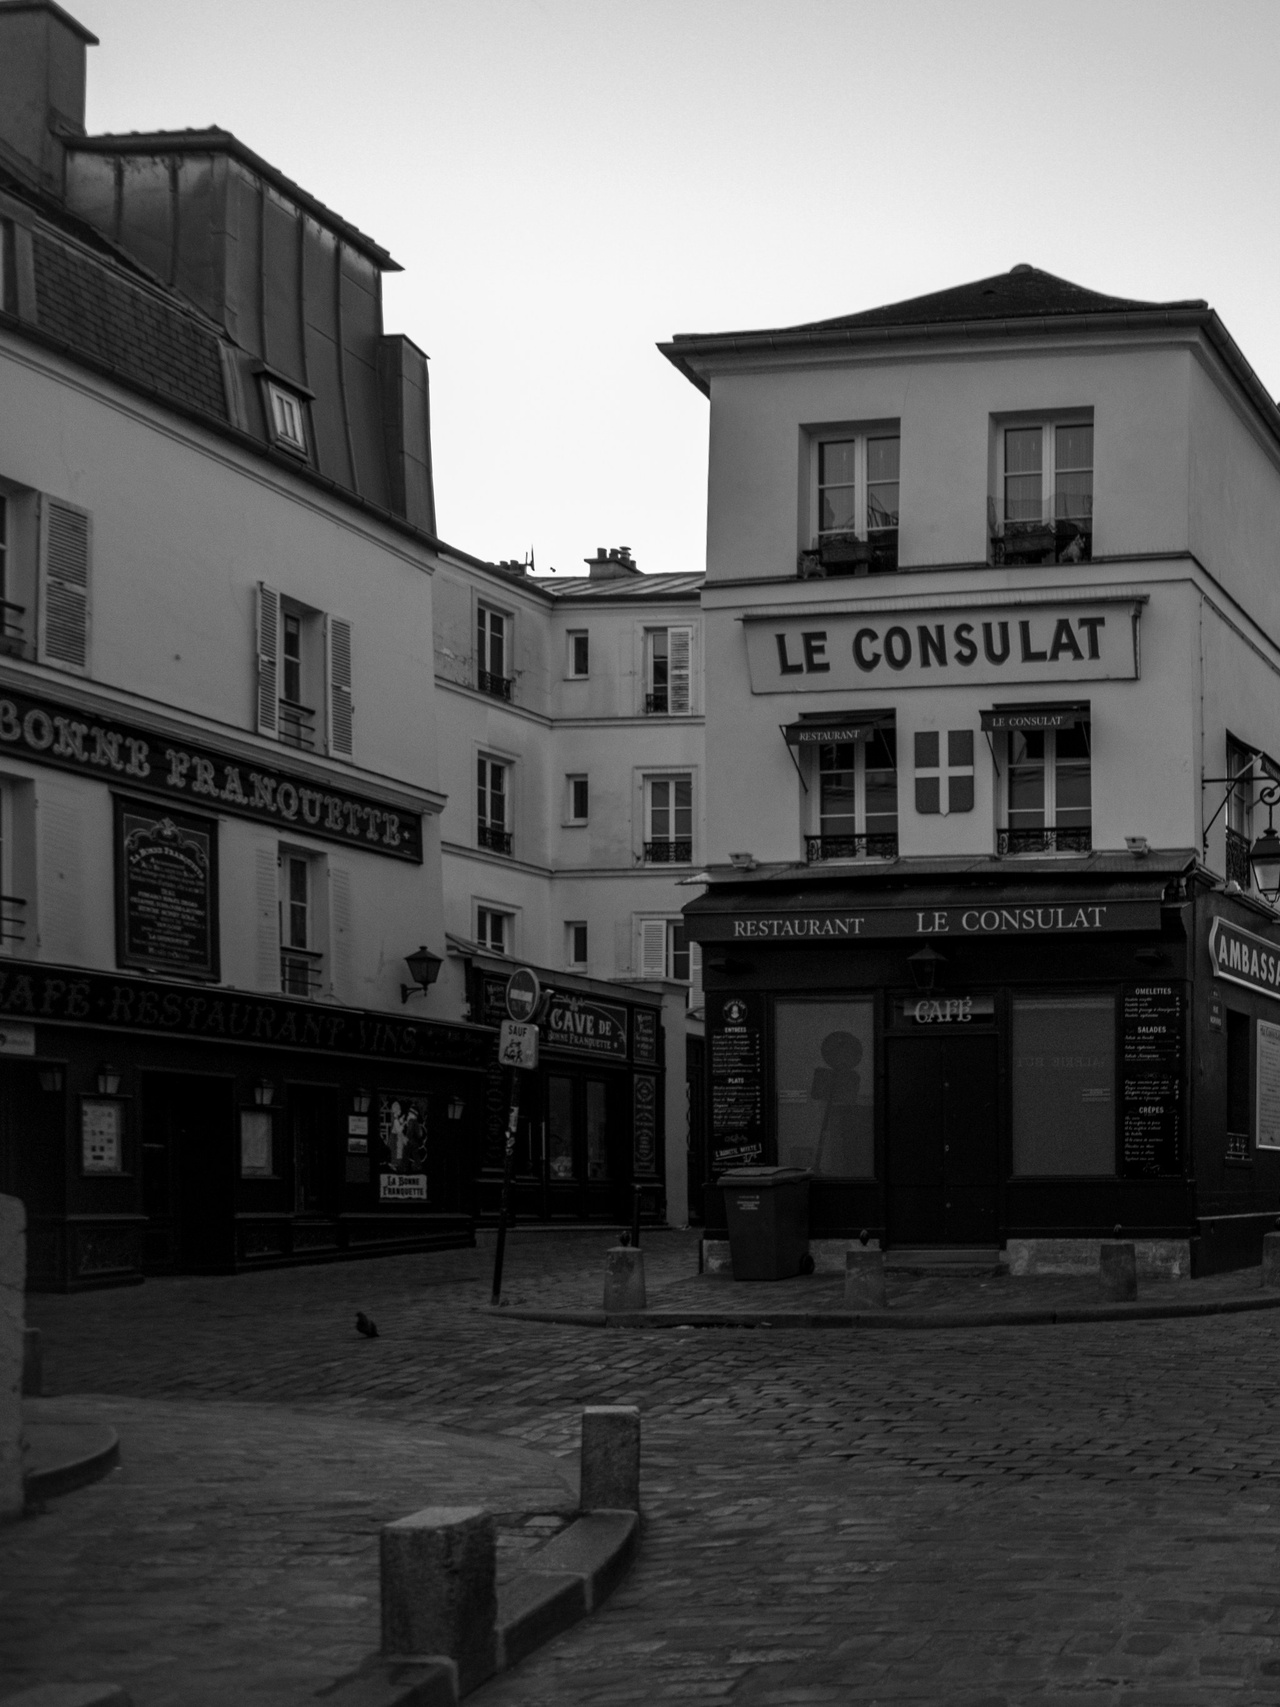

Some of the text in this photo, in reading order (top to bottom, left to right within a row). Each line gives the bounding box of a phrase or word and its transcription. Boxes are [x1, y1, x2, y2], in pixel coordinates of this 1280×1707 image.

[775, 617, 1105, 675] LE CONSULAT
[992, 715, 1063, 728] LE CONSULAT
[799, 729, 860, 743] RESTAURANT
[0, 699, 401, 846] BONNE FRANQUETTE
[733, 906, 1107, 937] RESTAURANT LE CONSULAT
[1135, 987, 1172, 995] OMELETTES
[914, 996, 973, 1025] CAFÉ
[107, 985, 346, 1047] RESTAURANT
[359, 1018, 418, 1055] VINS
[550, 1008, 594, 1037] CAVE
[598, 1020, 613, 1037] DE
[508, 1023, 528, 1037] SAUF
[1137, 1026, 1167, 1034] SALADES
[569, 1034, 612, 1051] FRANQUETTE
[398, 1176, 420, 1187] BONNE
[383, 1187, 425, 1198] FRANQUETTE
